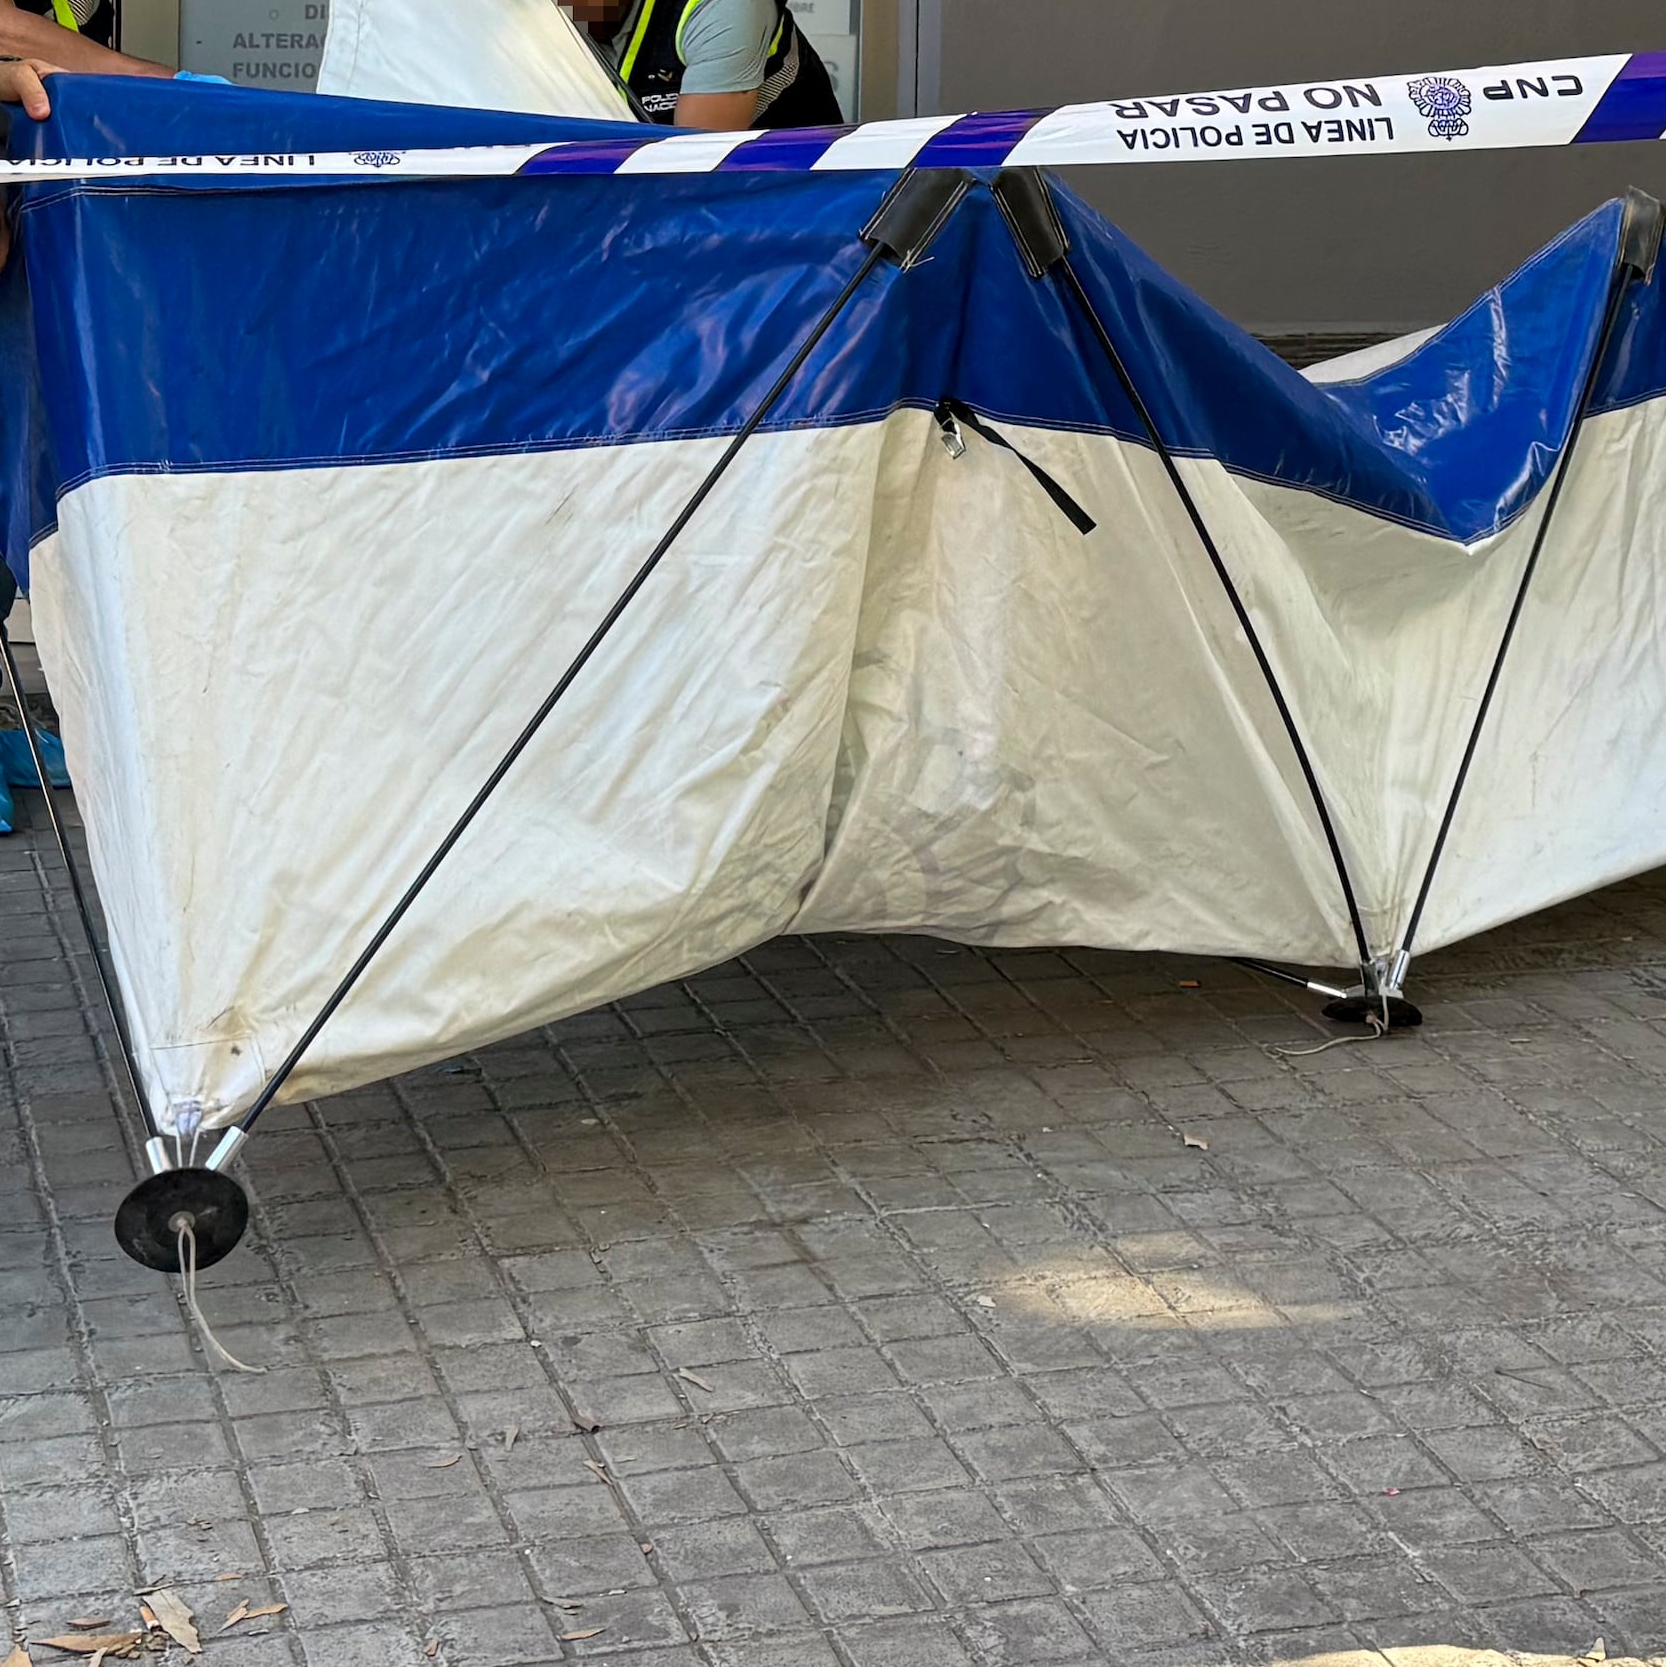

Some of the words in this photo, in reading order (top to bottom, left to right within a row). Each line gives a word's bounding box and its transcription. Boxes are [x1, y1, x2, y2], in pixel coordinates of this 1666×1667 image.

[1304, 83, 1383, 109] NO
[1482, 74, 1583, 101] CNP
[1114, 89, 1290, 120] PASAR
[1117, 124, 1244, 150] POLICIA
[1255, 122, 1295, 145] DE
[1309, 116, 1394, 142] LINEA
